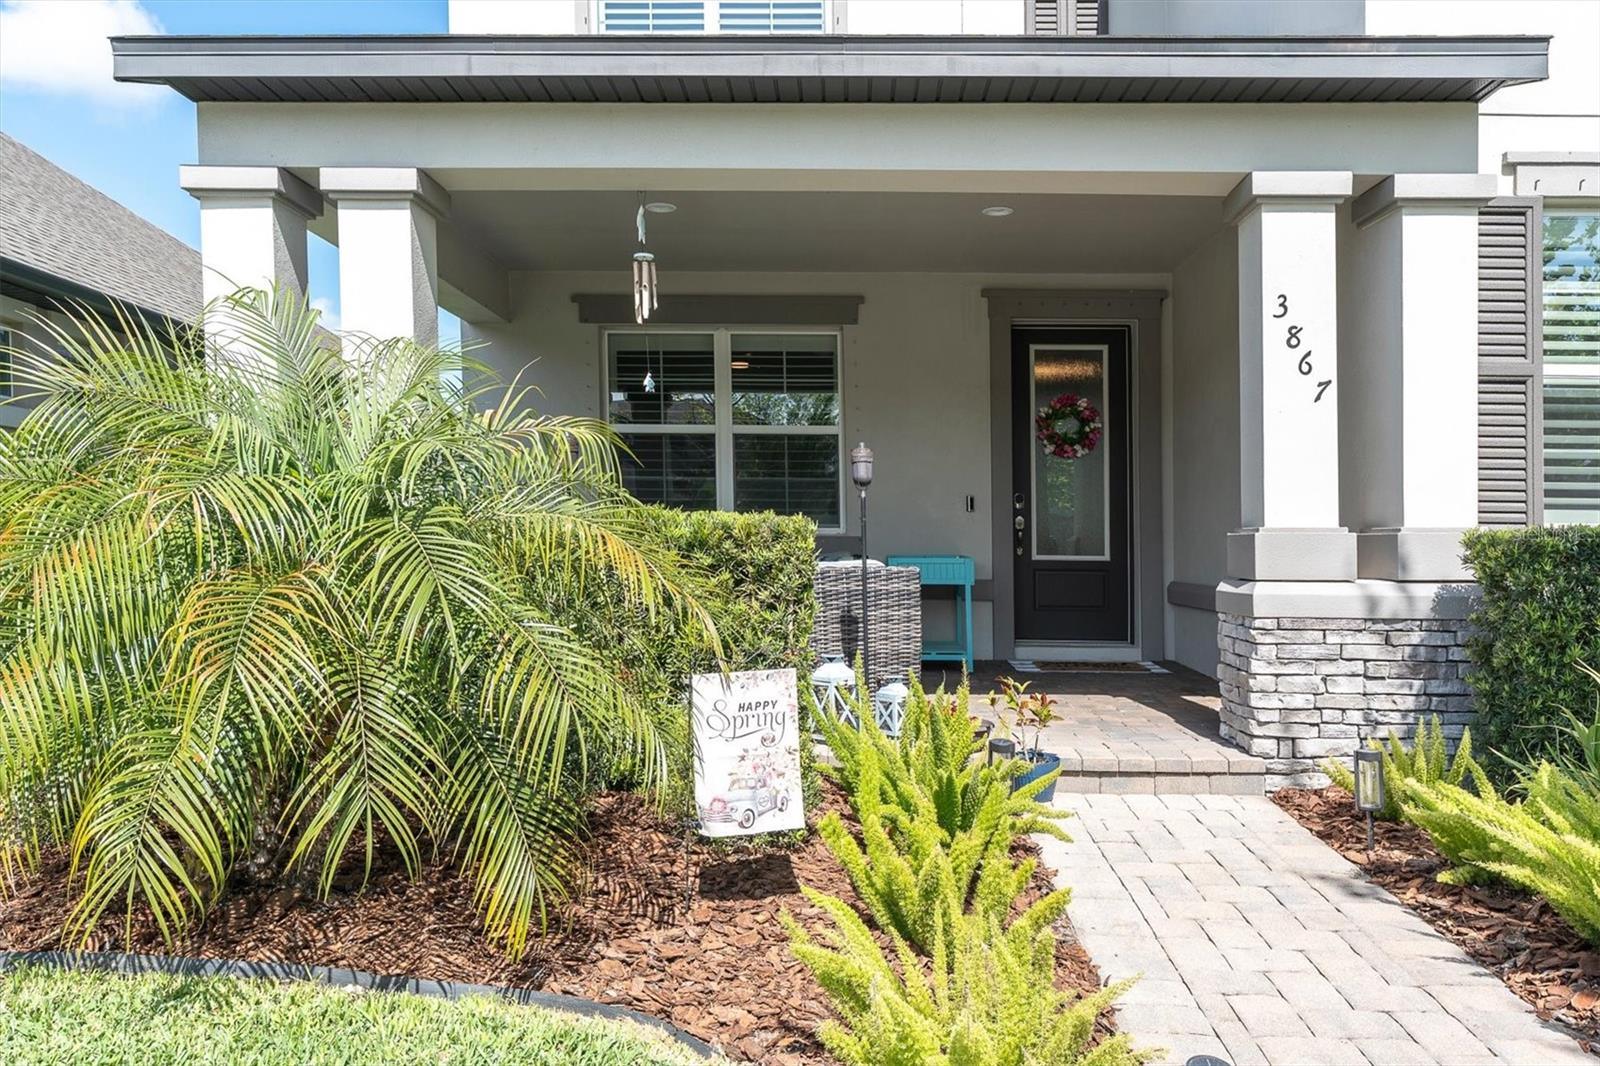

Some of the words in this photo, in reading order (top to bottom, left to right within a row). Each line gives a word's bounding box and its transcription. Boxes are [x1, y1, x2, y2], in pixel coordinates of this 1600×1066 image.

[1272, 293, 1332, 403] 3867
[706, 699, 786, 747] Spring
[738, 700, 778, 712] HAPPY
